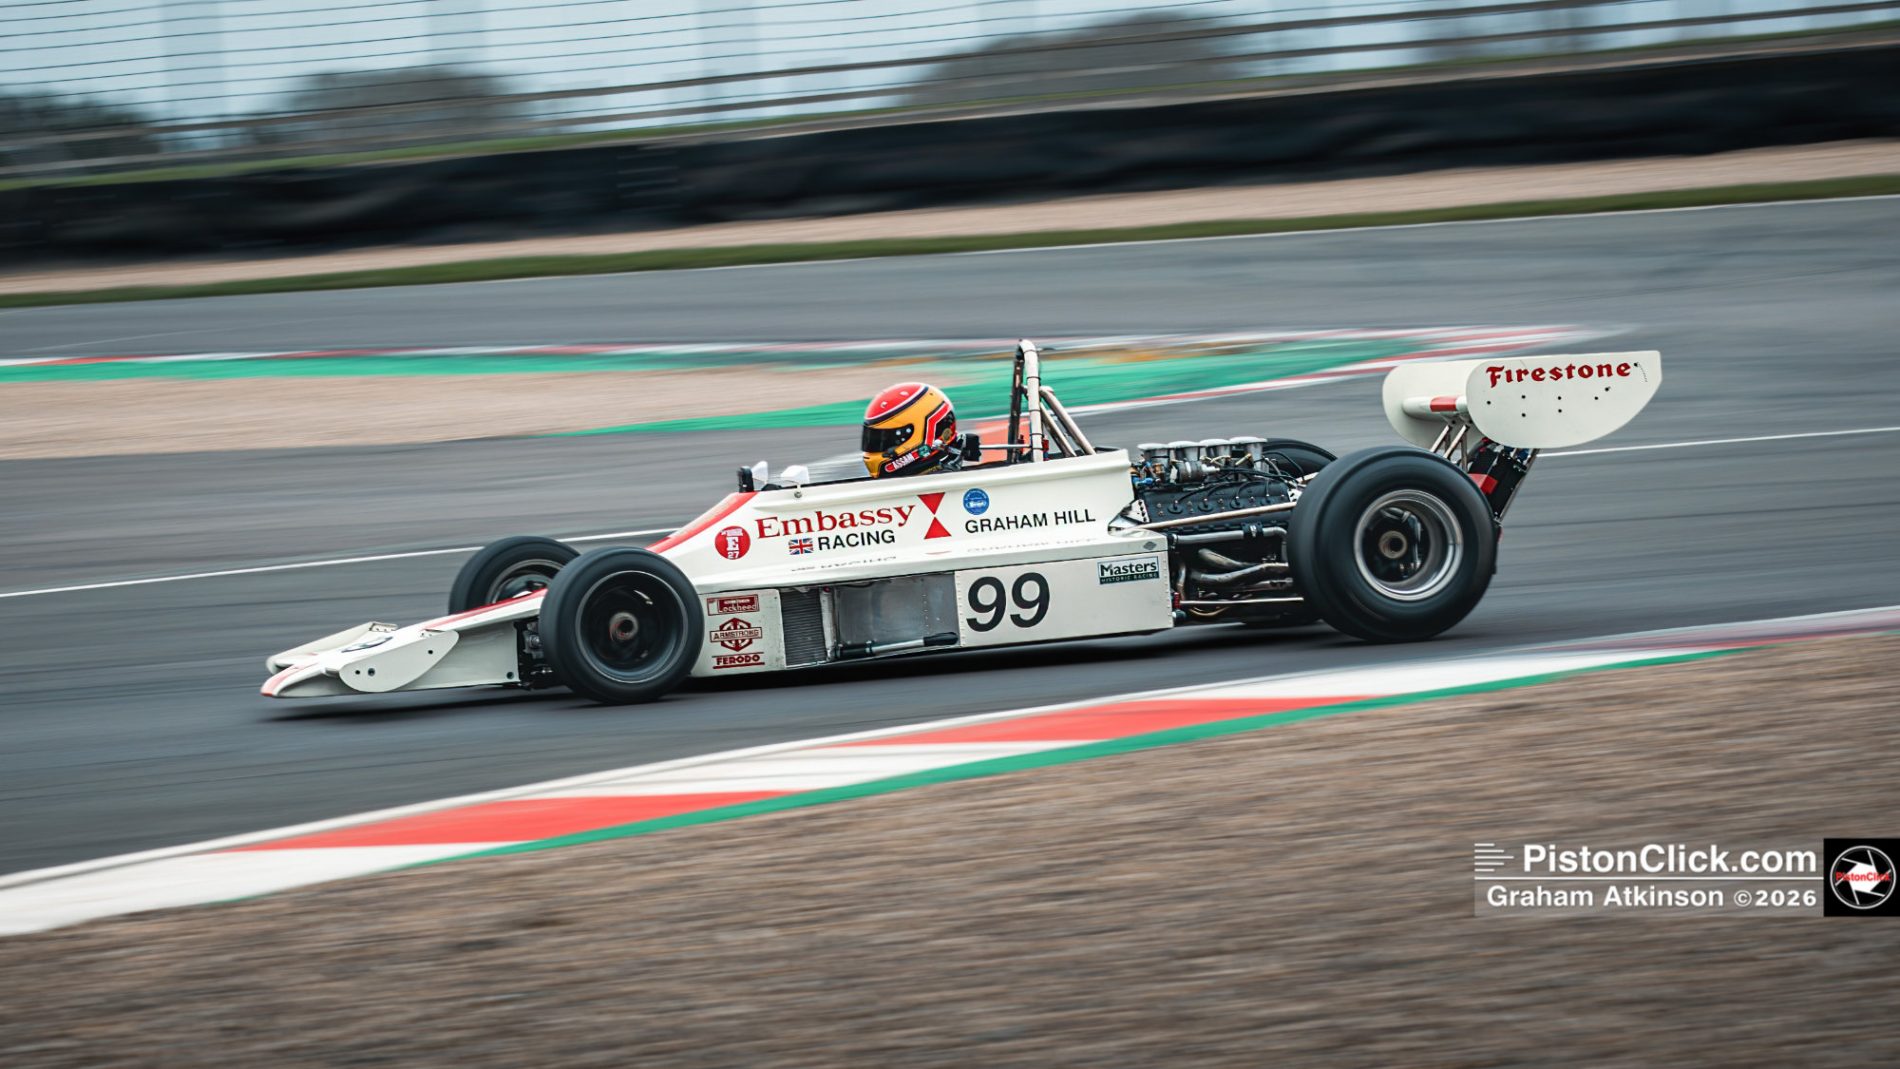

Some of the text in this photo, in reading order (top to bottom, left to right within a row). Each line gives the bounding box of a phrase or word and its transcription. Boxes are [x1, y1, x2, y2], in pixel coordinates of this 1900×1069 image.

[1486, 362, 1631, 388] Firestone
[755, 505, 915, 539] Embassy
[965, 509, 1096, 533] GRAHAM HILL
[818, 529, 896, 551] RACING
[1100, 562, 1157, 576] Masters
[966, 572, 1050, 632] 99
[716, 654, 761, 666] FERODO
